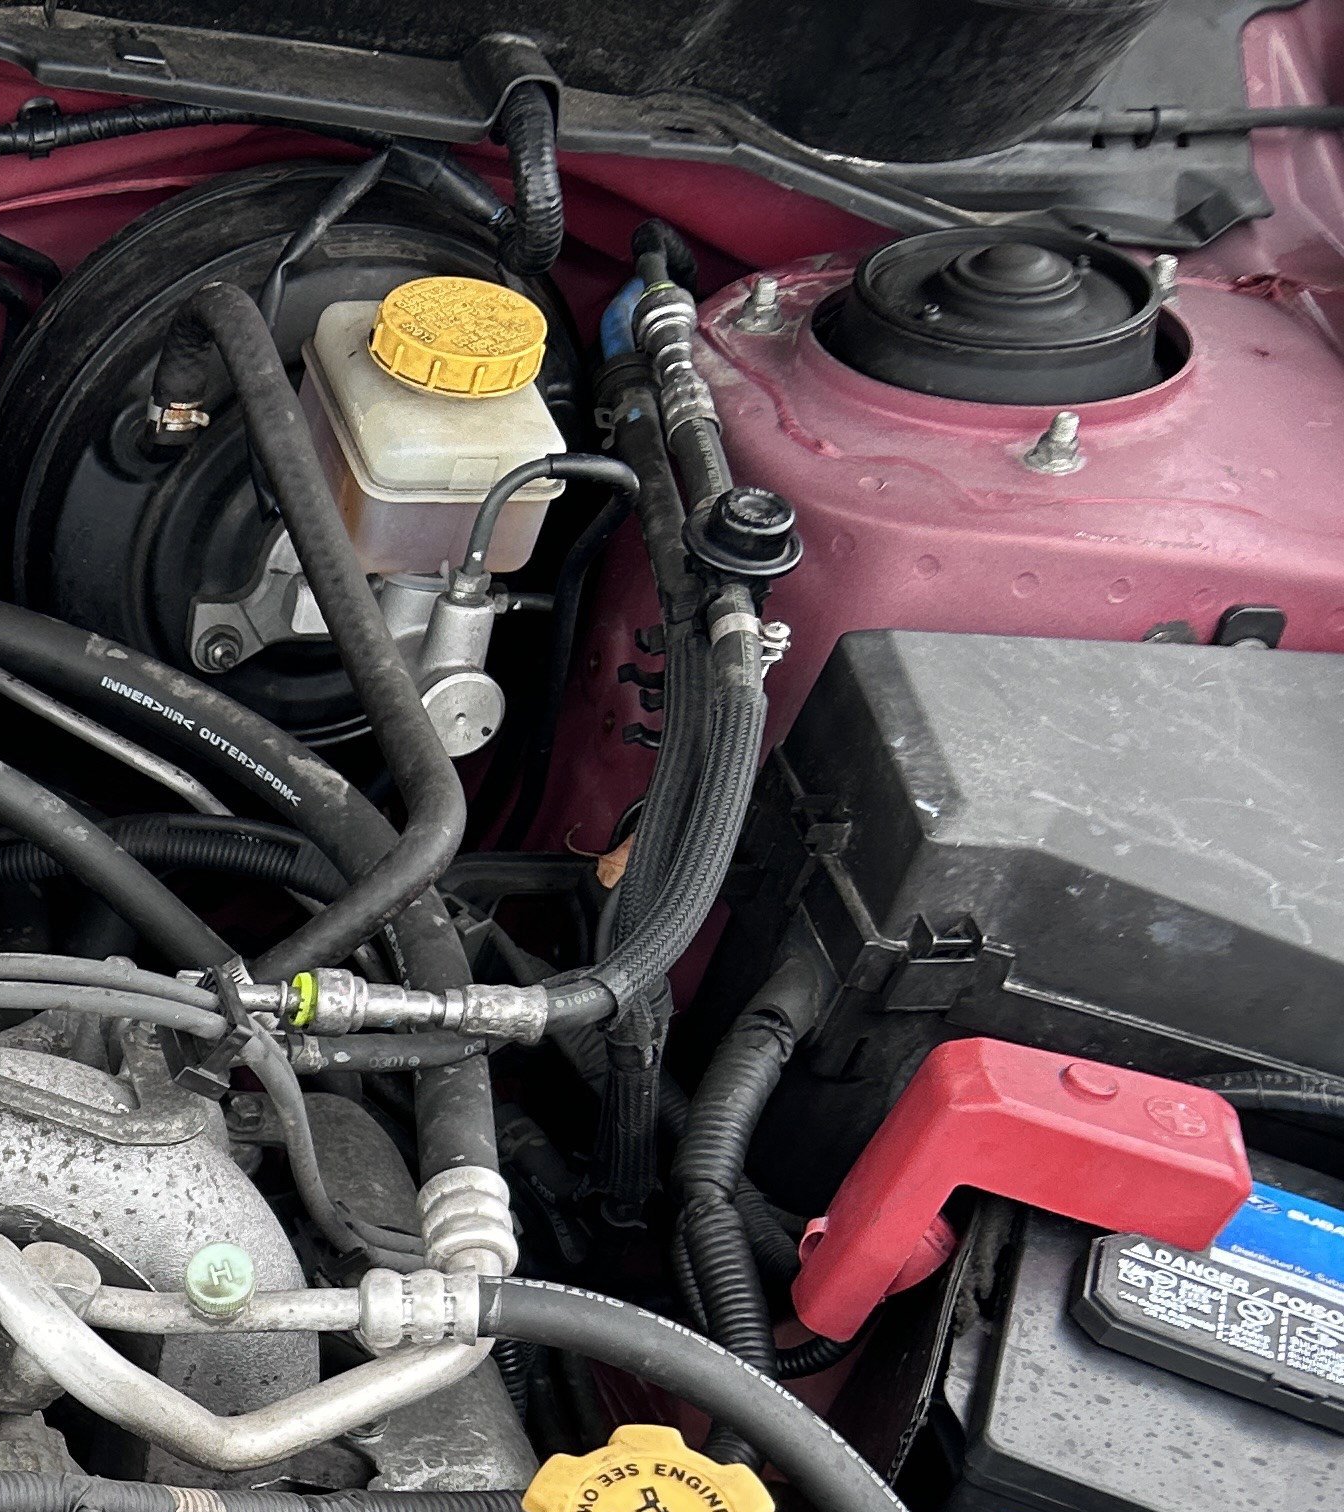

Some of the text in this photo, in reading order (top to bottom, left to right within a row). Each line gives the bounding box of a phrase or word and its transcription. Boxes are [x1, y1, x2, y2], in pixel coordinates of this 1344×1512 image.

[199, 726, 302, 808] OUTER>EPDM<
[208, 1260, 233, 1287] H
[1154, 1249, 1250, 1293] DANGER
[1272, 1291, 1344, 1325] POISO
[598, 1462, 640, 1488] SEE
